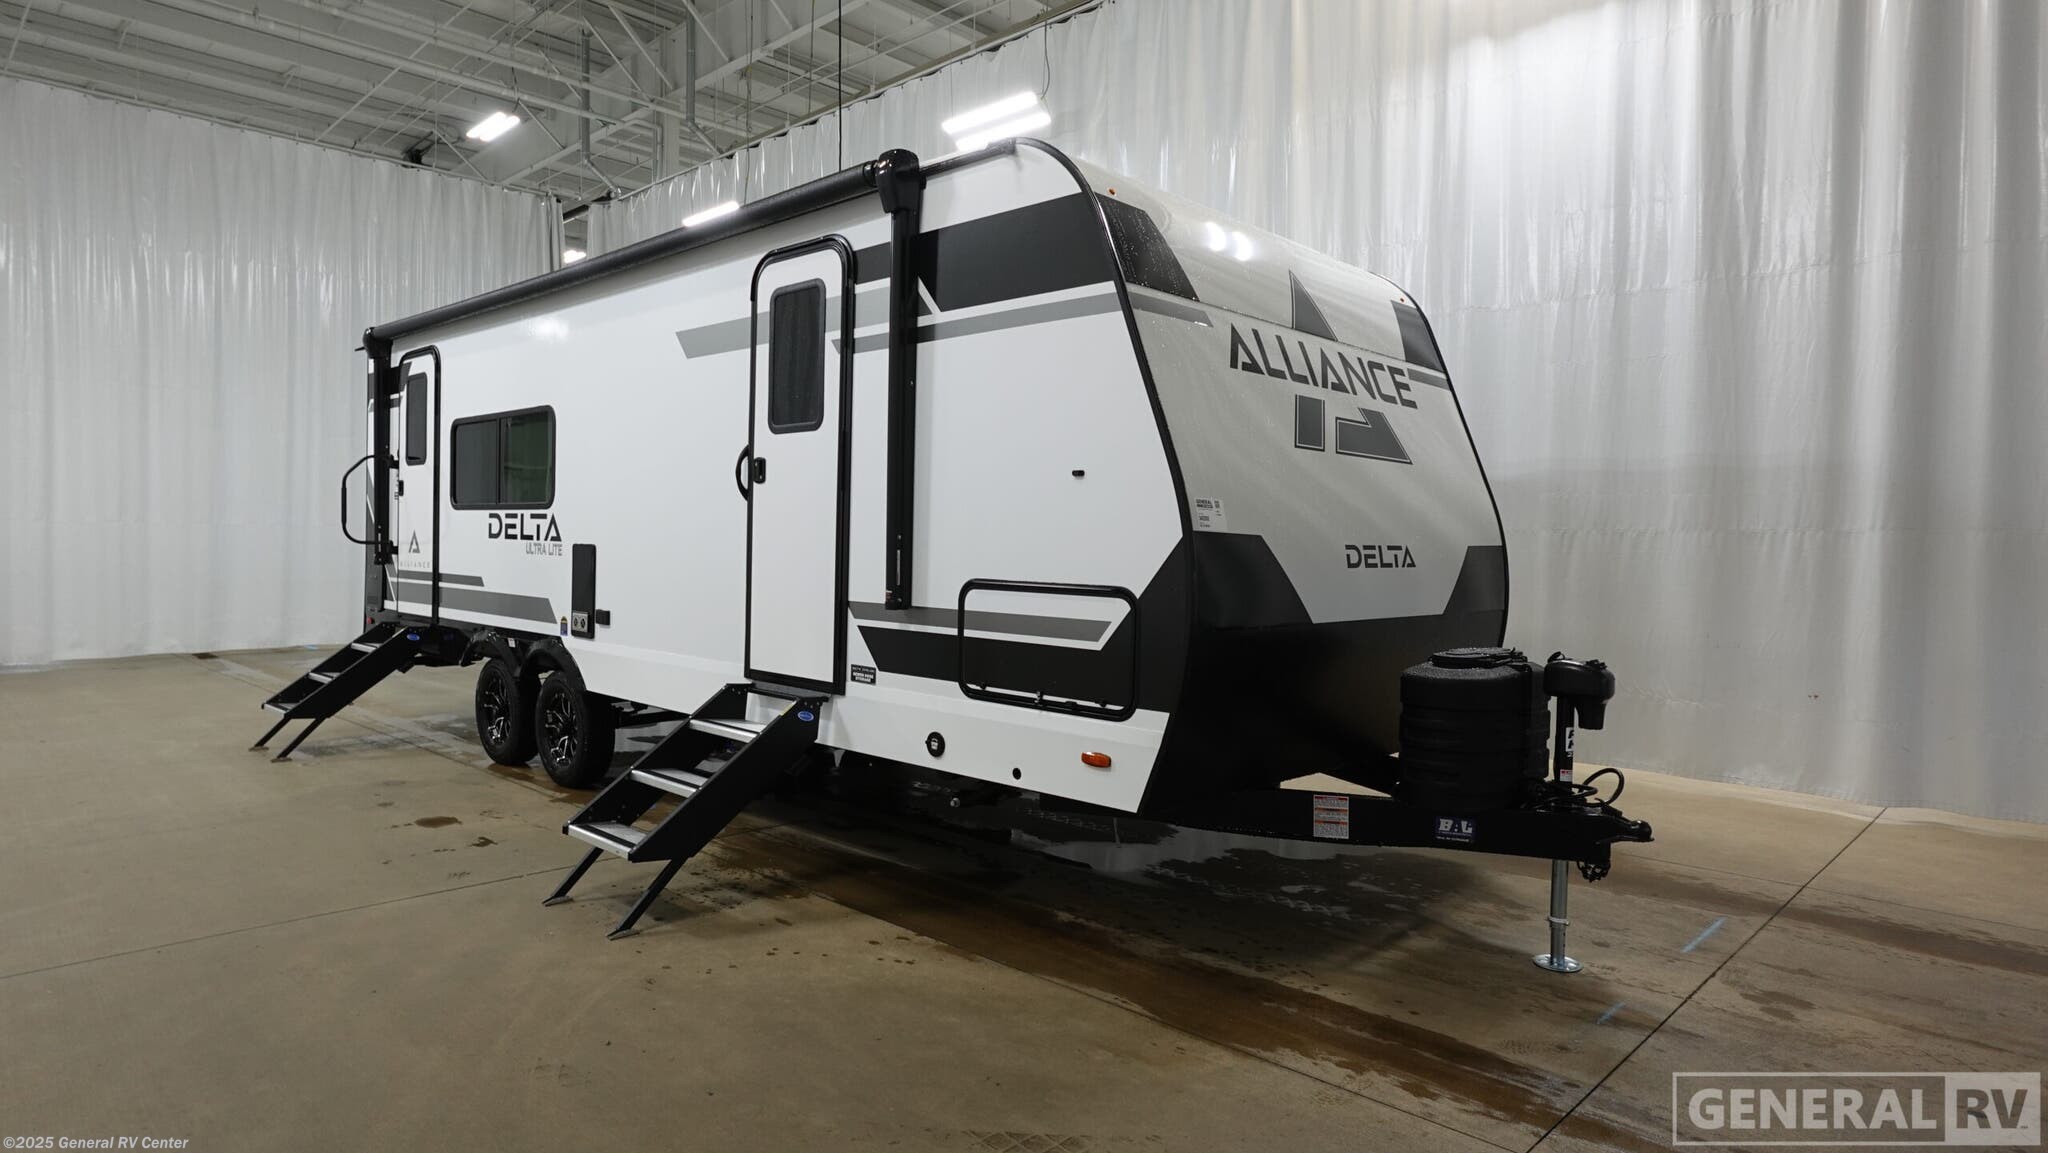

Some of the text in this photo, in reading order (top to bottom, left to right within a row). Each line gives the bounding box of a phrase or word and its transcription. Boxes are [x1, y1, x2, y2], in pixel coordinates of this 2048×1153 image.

[1230, 322, 1418, 410] ALLIANCE
[488, 512, 562, 542] DELTA
[526, 542, 563, 556] ULTRA LITE
[1345, 544, 1416, 568] DELTA
